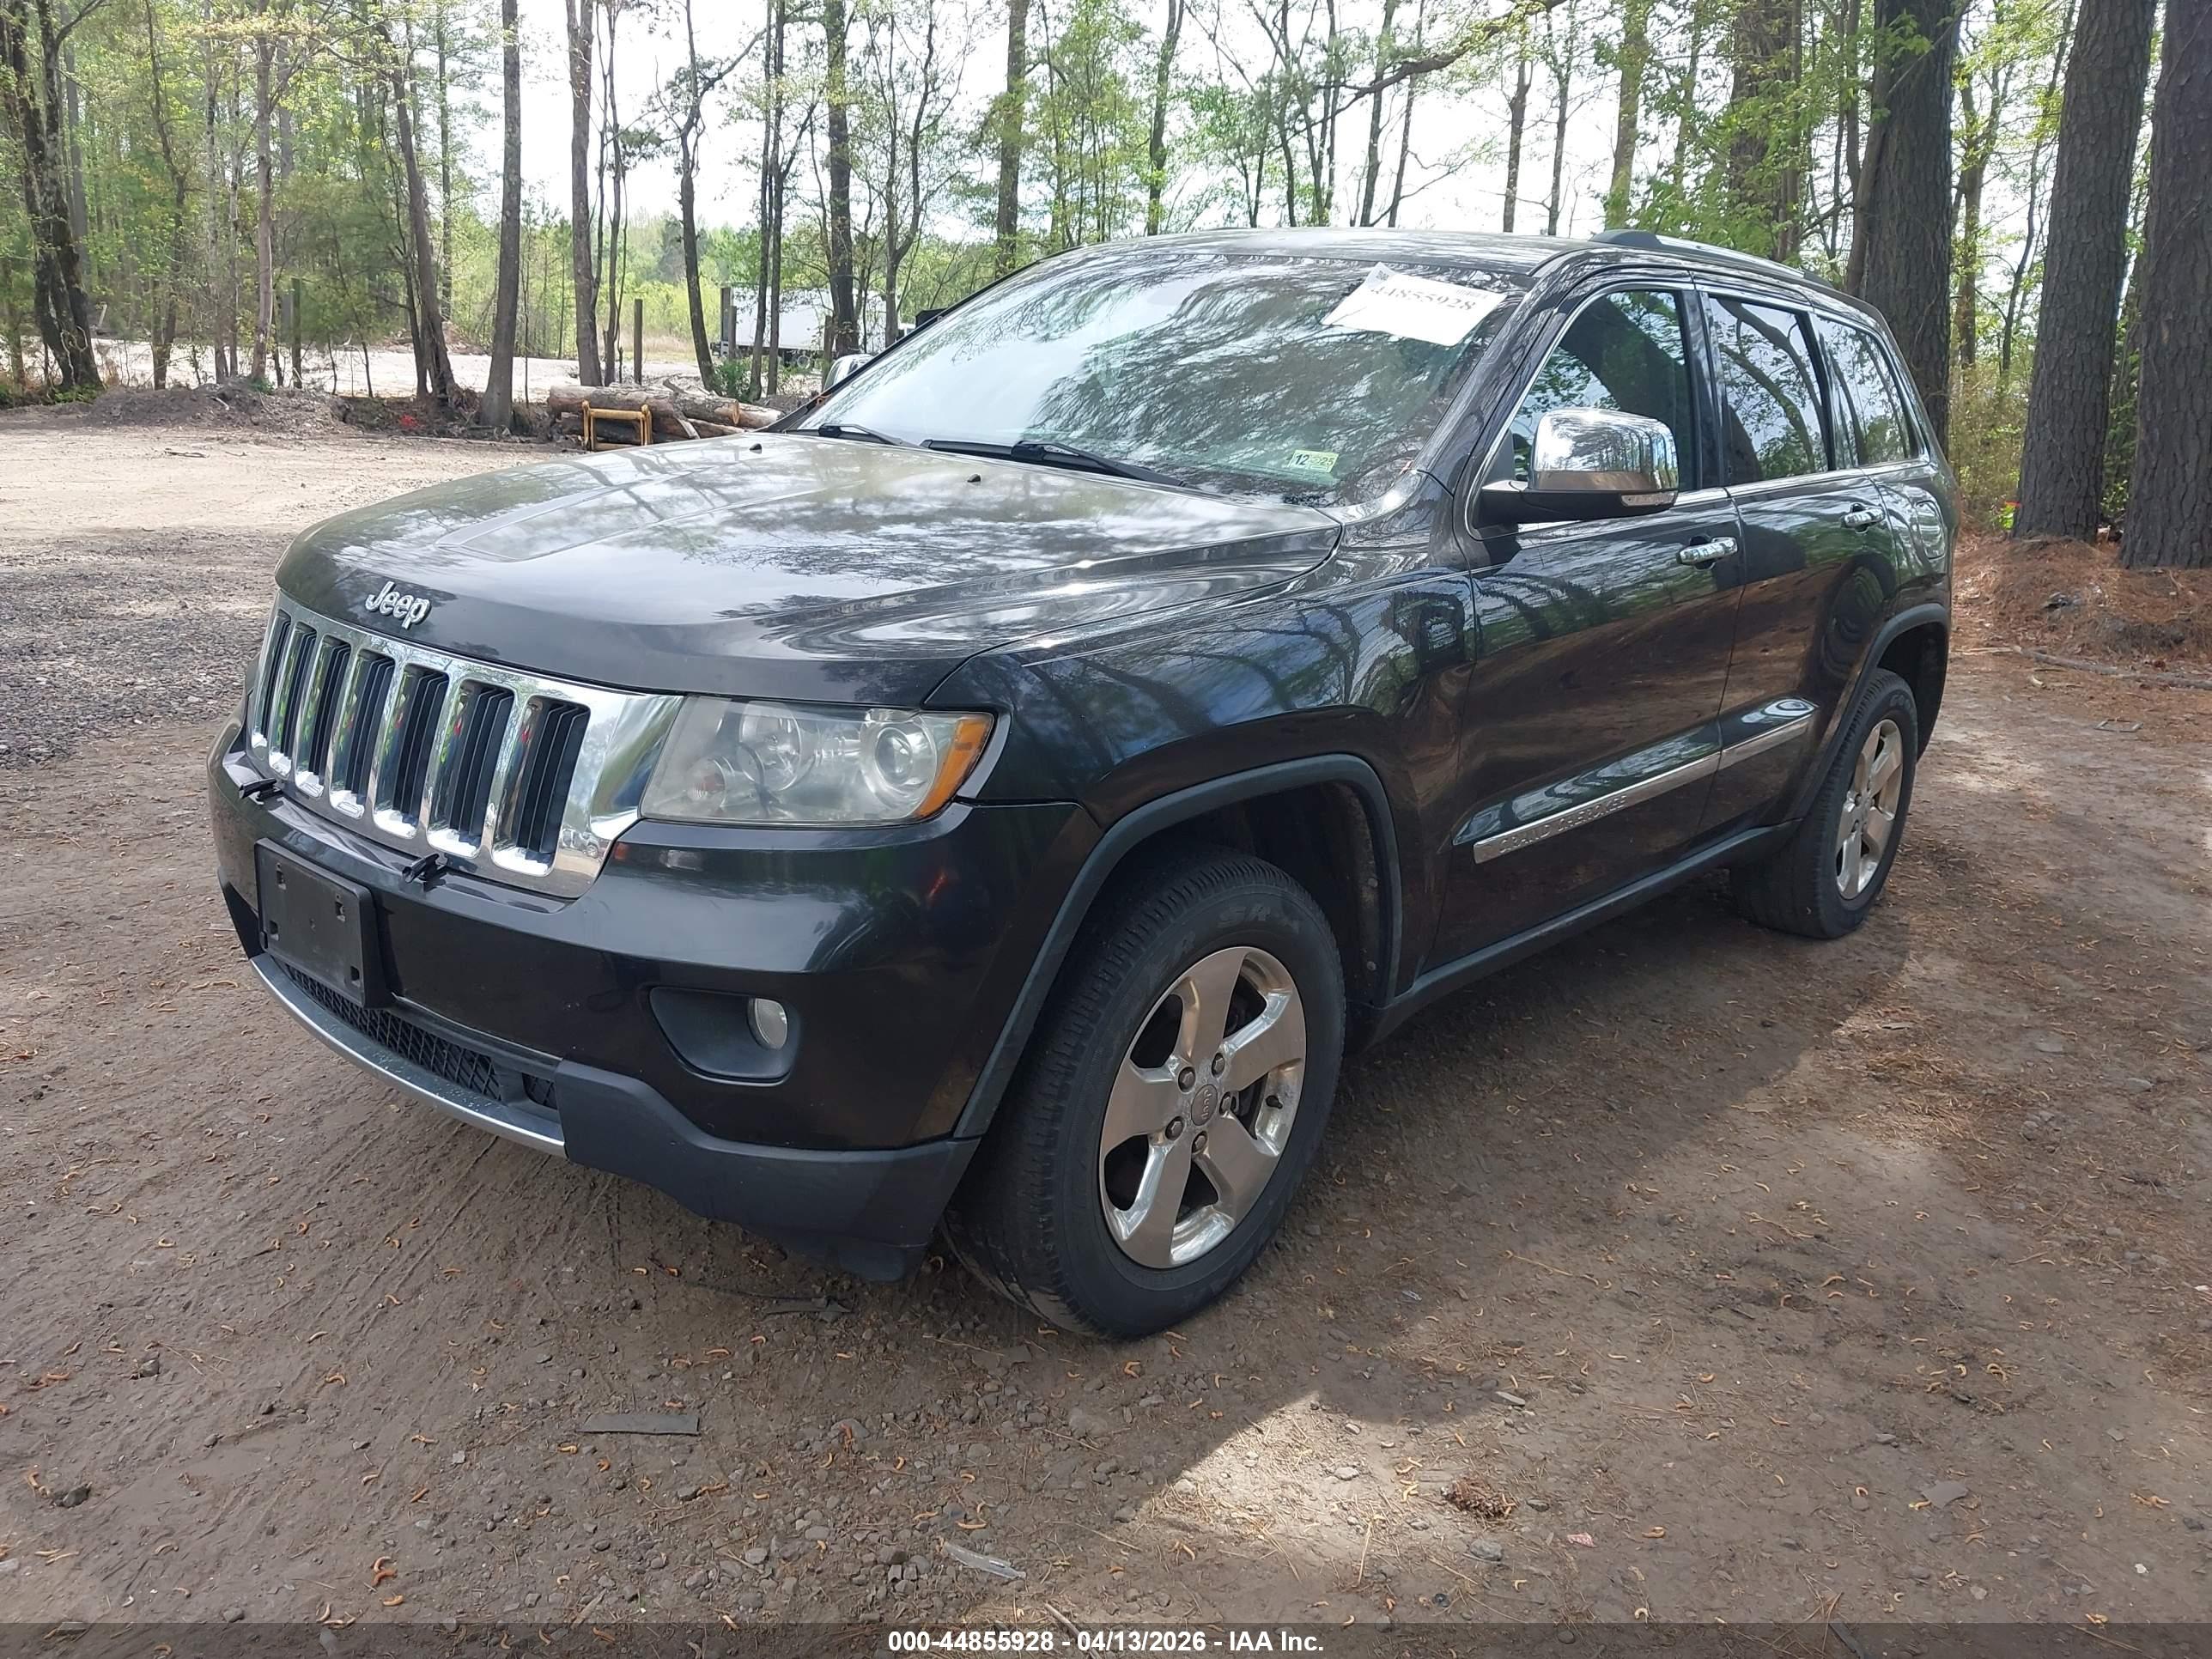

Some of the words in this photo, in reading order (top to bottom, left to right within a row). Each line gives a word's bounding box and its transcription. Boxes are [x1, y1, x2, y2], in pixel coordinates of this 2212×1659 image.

[1295, 453, 1310, 465] 12
[1319, 457, 1335, 466] 25
[365, 580, 430, 629] Jeep
[1559, 795, 1627, 831] CHEROKEE
